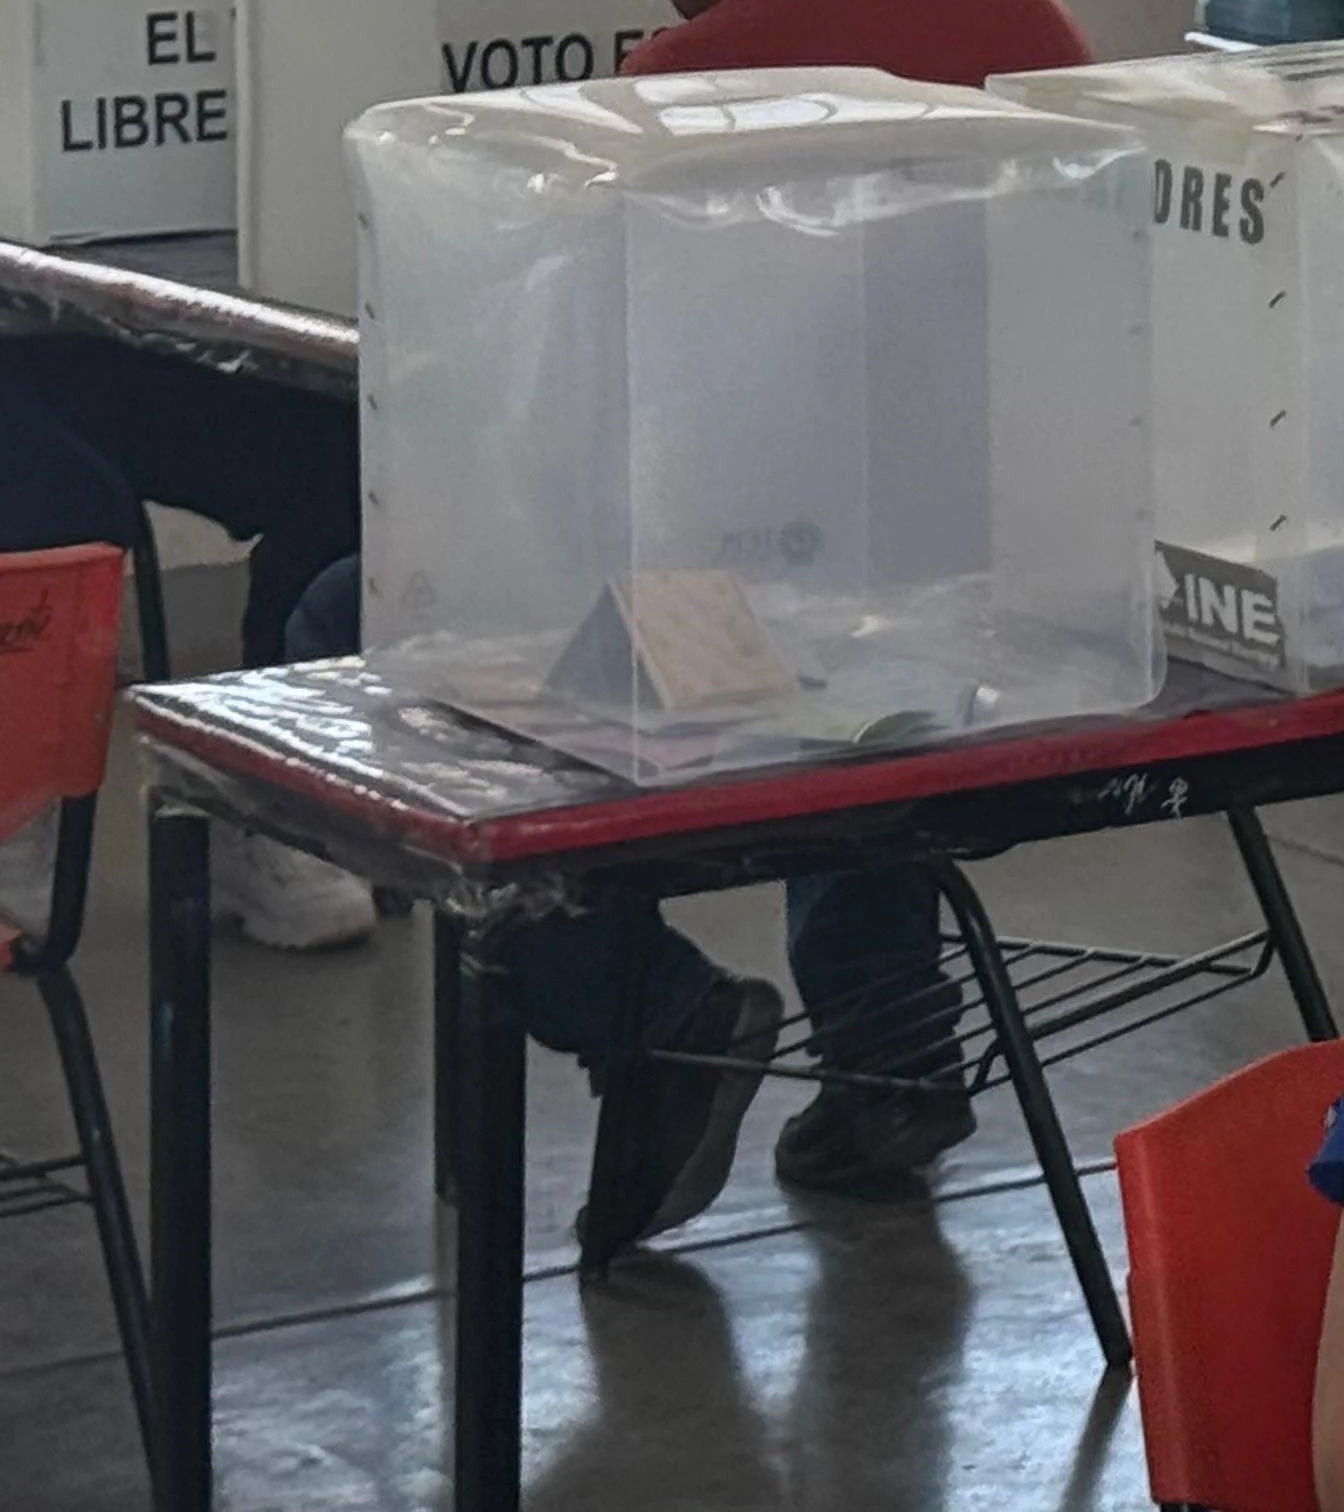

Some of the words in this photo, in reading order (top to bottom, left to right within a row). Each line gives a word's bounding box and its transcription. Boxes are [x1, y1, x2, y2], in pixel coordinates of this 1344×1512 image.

[147, 10, 217, 66] EL
[442, 33, 594, 93] VOTO
[61, 89, 229, 152] LIBRE
[1184, 572, 1281, 646] INE
